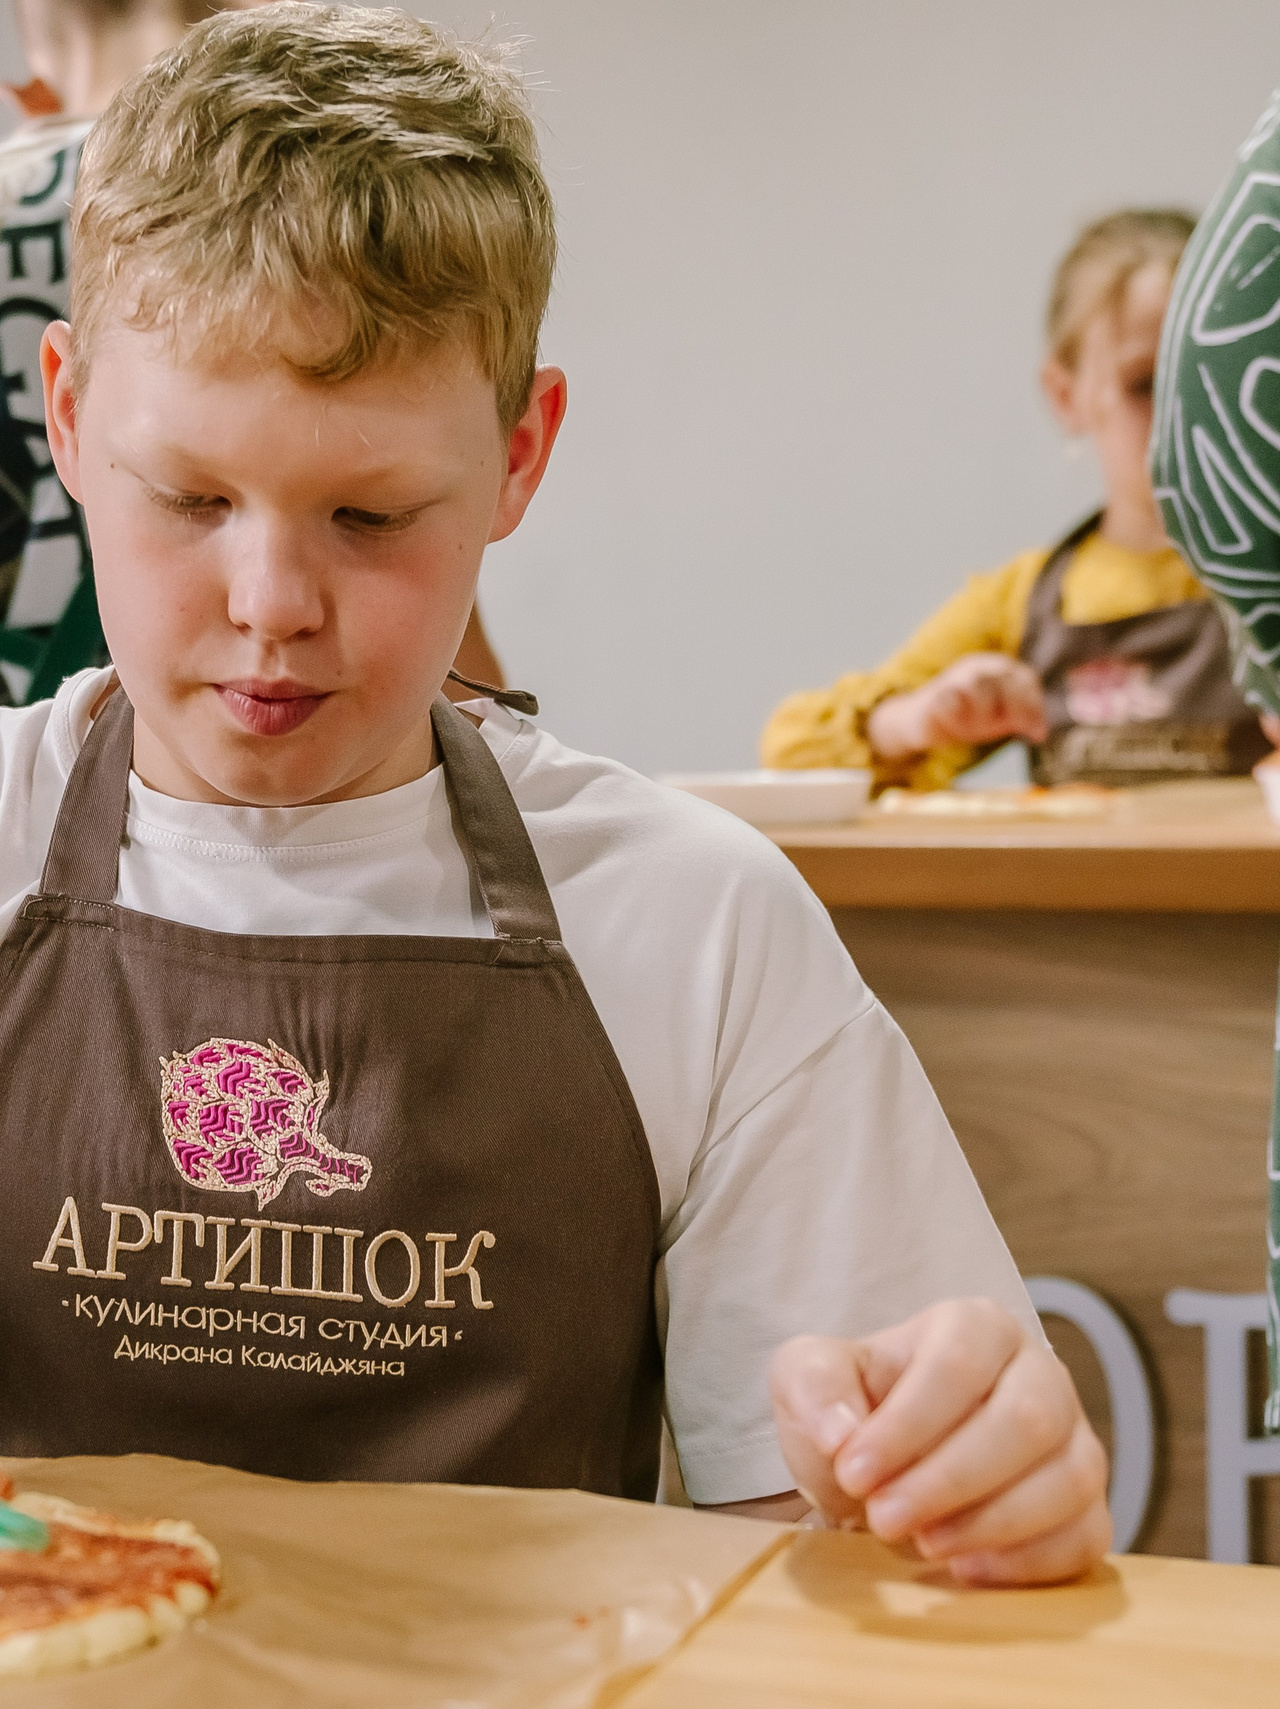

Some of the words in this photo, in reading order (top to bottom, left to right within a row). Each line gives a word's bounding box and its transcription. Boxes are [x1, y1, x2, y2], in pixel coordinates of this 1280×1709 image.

[32, 1196, 496, 1310] АРТИШОК
[74, 1293, 306, 1340] кулинарная
[318, 1318, 448, 1351] студия
[113, 1334, 233, 1365] Дикрана
[241, 1344, 406, 1377] Калайджяна
